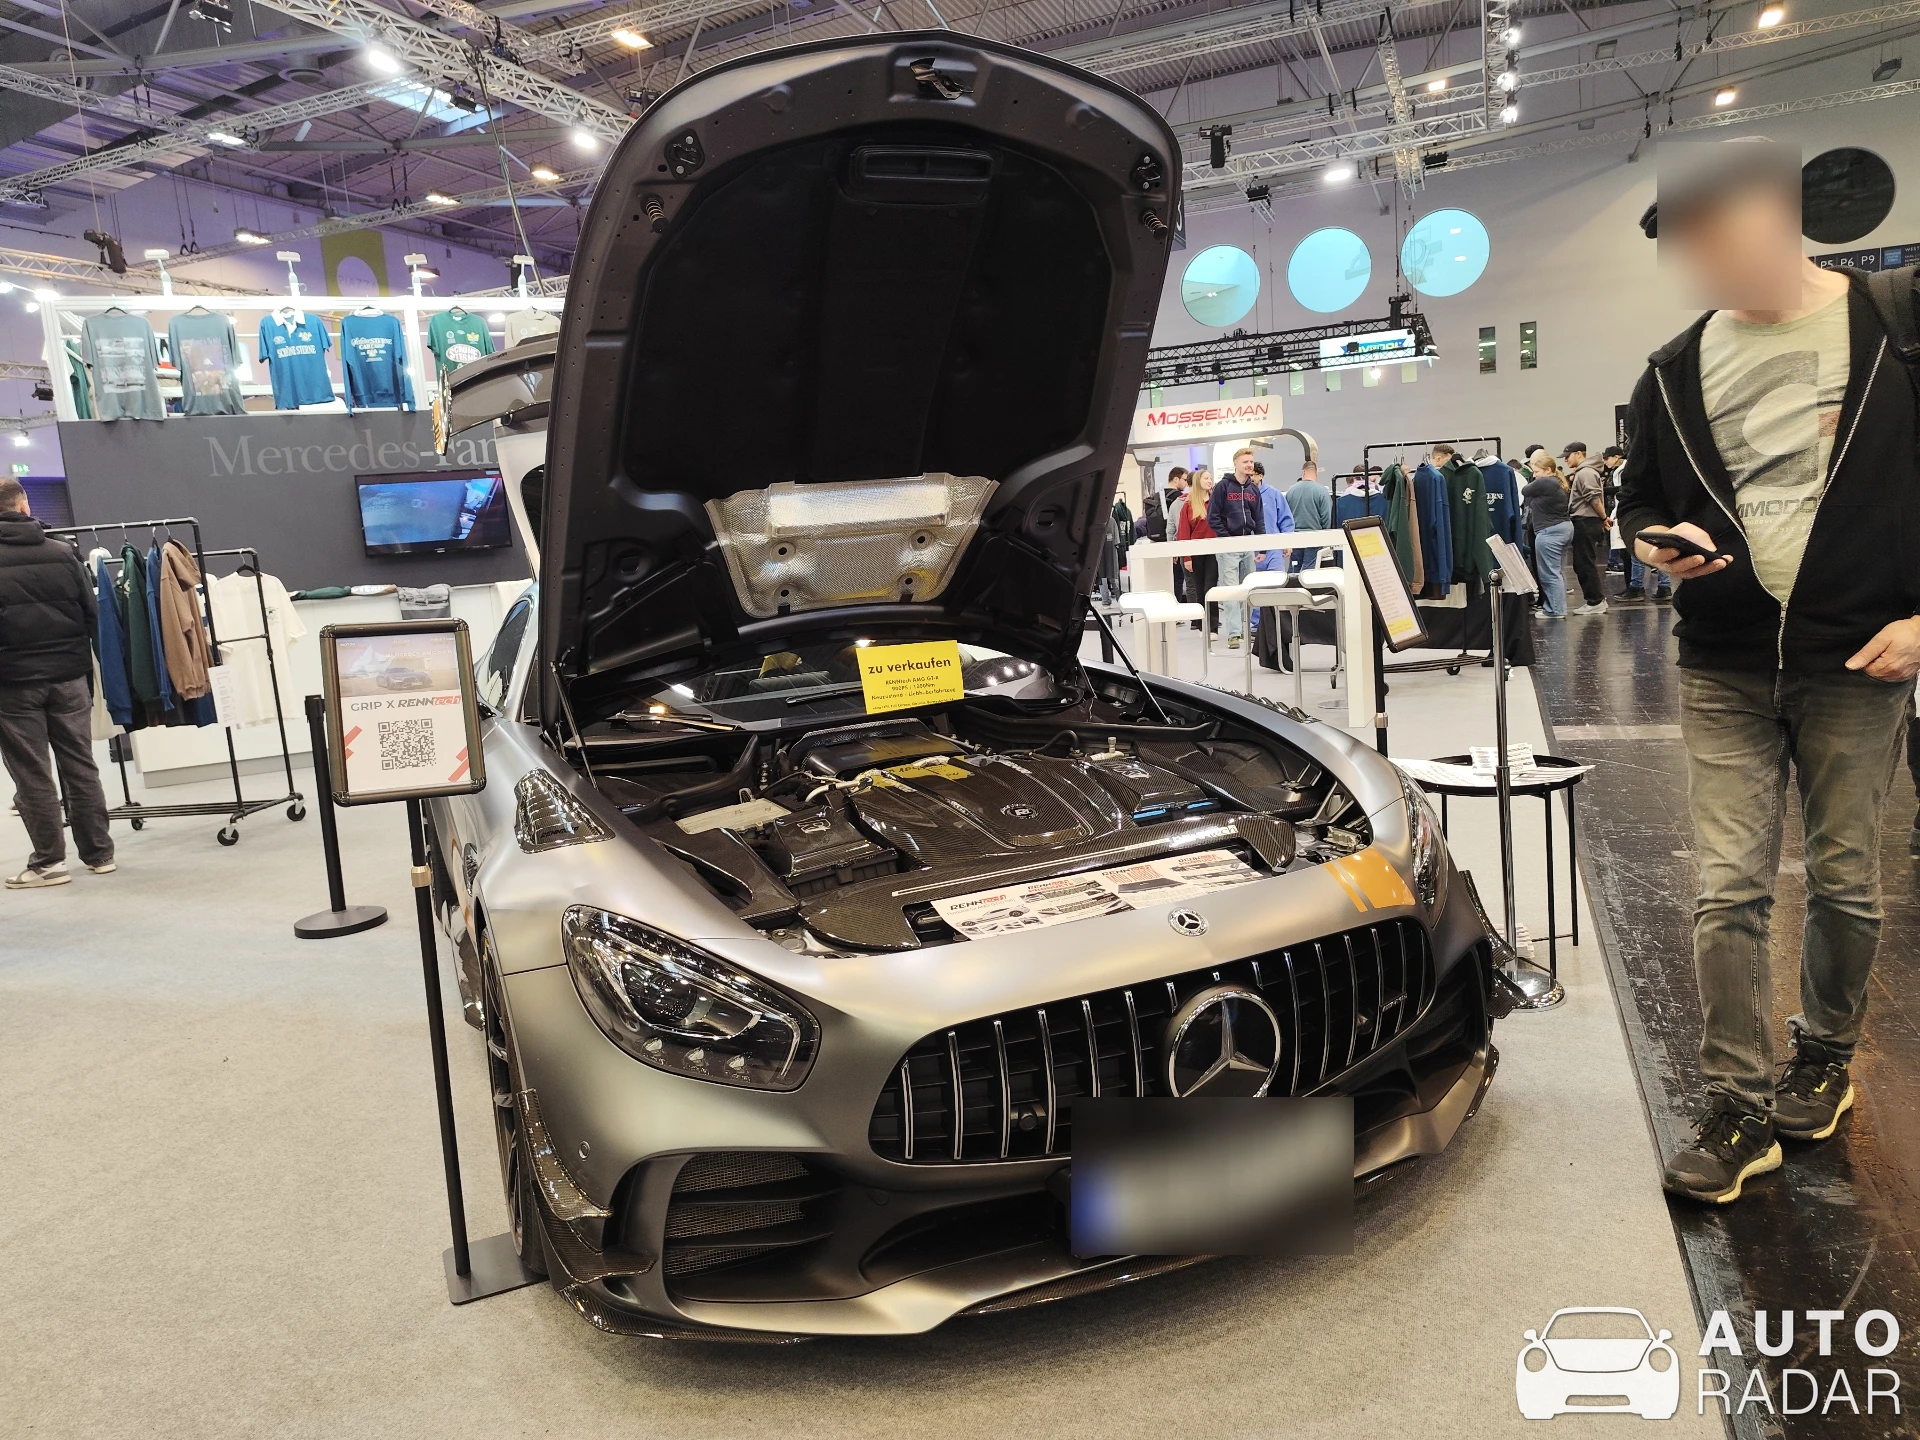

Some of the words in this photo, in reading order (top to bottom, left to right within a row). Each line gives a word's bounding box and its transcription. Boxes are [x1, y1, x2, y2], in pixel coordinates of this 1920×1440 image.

[1840, 257, 1855, 267] P6
[1861, 255, 1875, 266] P9
[1147, 403, 1269, 426] MOSSELMAN
[1217, 416, 1268, 425] SYSTEMS
[868, 665, 883, 675] zu
[887, 657, 952, 673] verkaufen
[351, 702, 382, 712] GRIP
[386, 700, 396, 709] X
[398, 695, 462, 708] RENNtech
